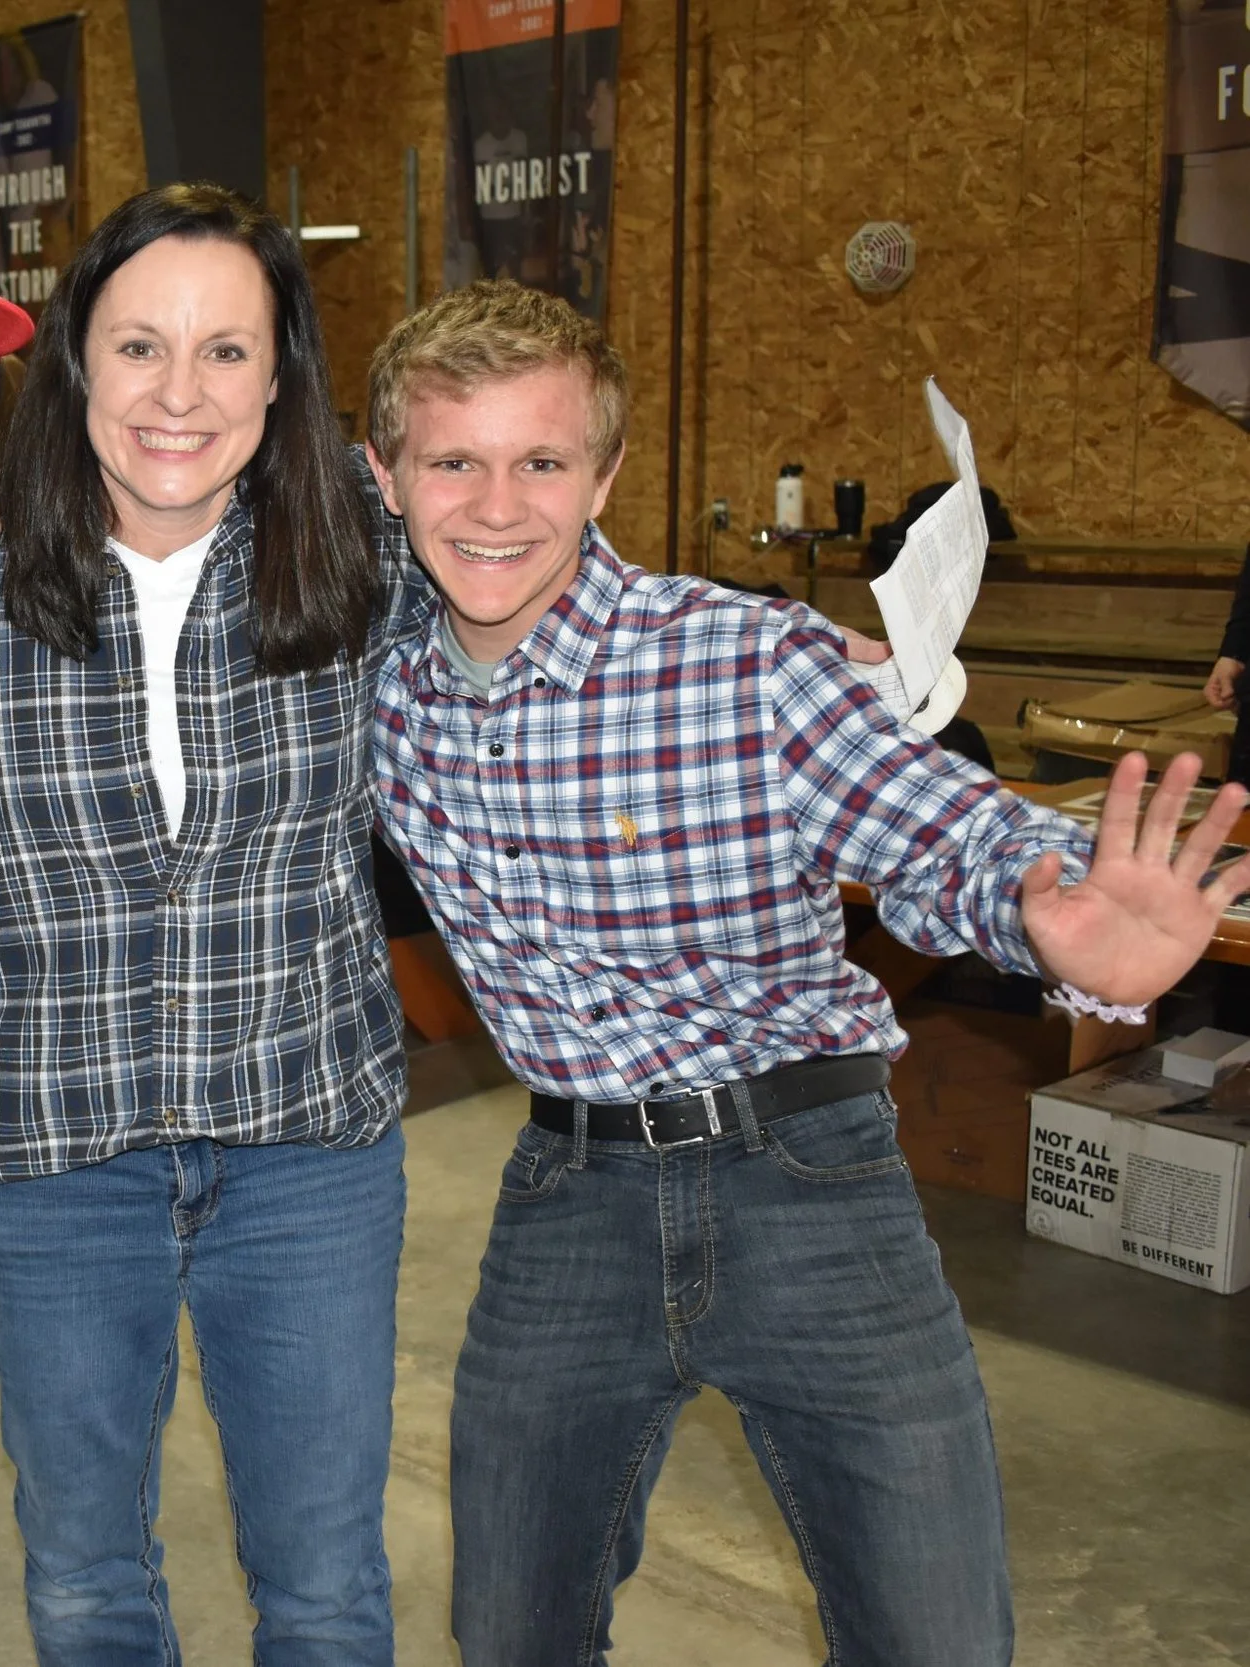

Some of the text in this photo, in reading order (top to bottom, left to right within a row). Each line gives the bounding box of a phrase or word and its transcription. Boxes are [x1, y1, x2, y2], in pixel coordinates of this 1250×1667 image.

[9, 219, 43, 255] THE
[1035, 1127, 1111, 1162] NOT ALL
[1034, 1147, 1120, 1185] TEES ARE
[1031, 1185, 1094, 1219] EQUAL.
[1032, 1167, 1115, 1203] CREATED
[1122, 1239, 1214, 1279] BE DIFFERENT
